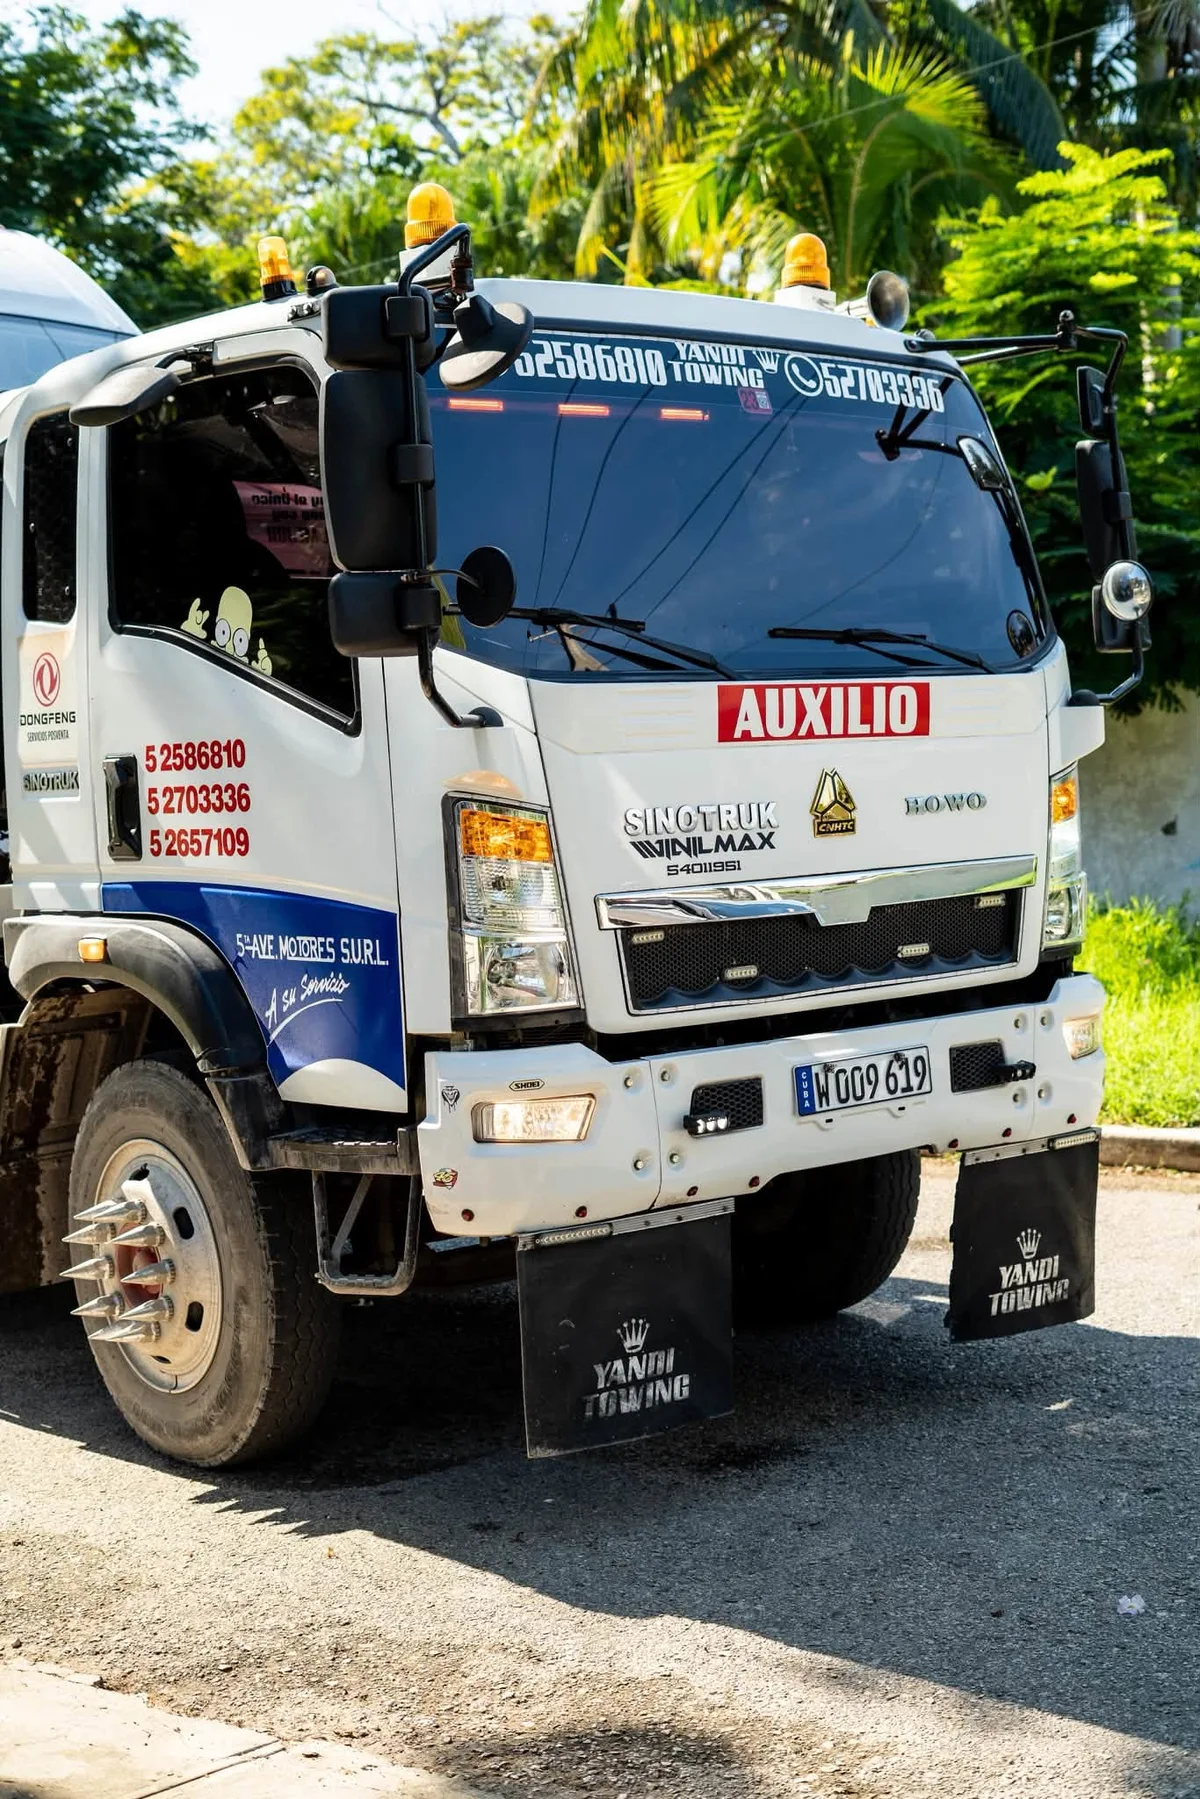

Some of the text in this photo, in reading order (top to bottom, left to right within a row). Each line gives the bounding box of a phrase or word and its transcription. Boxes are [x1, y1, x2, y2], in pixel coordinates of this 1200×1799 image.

[514, 340, 667, 386] 52586810
[674, 341, 746, 366] YANDI
[667, 360, 764, 388] TOWING
[822, 362, 945, 413] 52703336
[20, 711, 76, 726] DONGFENG
[733, 685, 918, 738] AUXILIO
[23, 771, 80, 792] SINOTRUK
[624, 801, 780, 837] SINOTRUK
[905, 792, 987, 816] HOWO
[818, 821, 854, 832] CNHTC
[667, 860, 742, 876] 54011951
[265, 988, 277, 1029] A
[514, 1081, 540, 1089] SHOEI
[801, 1071, 811, 1108] CUBA
[998, 1255, 1060, 1289] YANDI
[988, 1279, 1069, 1317] TOWING
[593, 1347, 675, 1389] YANDI
[582, 1374, 690, 1418] TOWING
